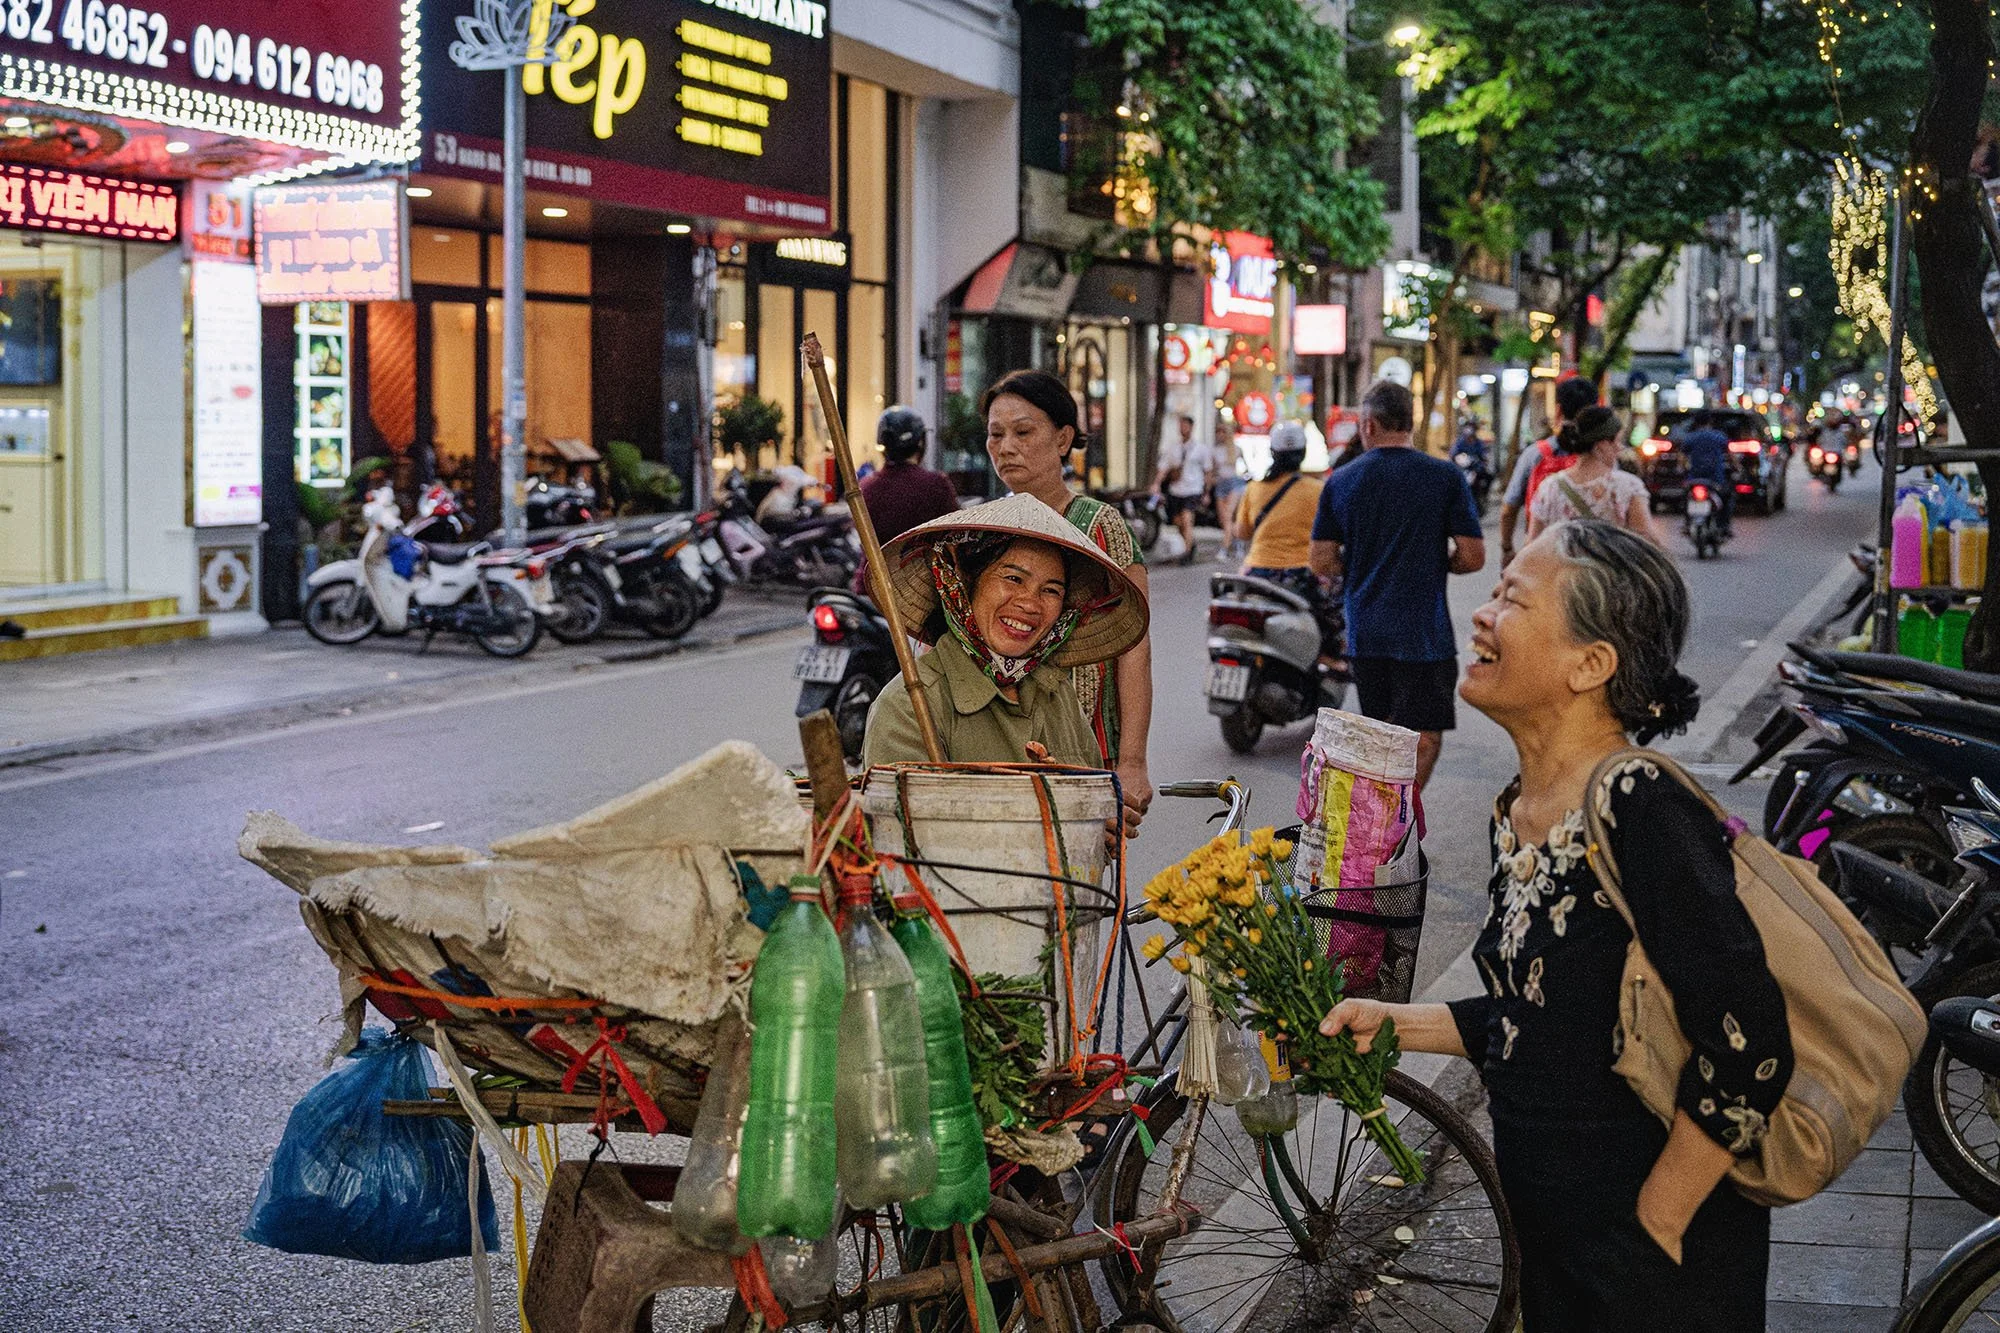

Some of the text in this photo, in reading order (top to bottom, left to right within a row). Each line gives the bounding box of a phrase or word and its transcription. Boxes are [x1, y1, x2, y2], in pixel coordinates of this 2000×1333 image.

[62, 0, 169, 68] 46852
[193, 24, 253, 85] 094
[256, 37, 312, 99] 612
[316, 51, 384, 114] 6968
[29, 175, 110, 223] VIÊM
